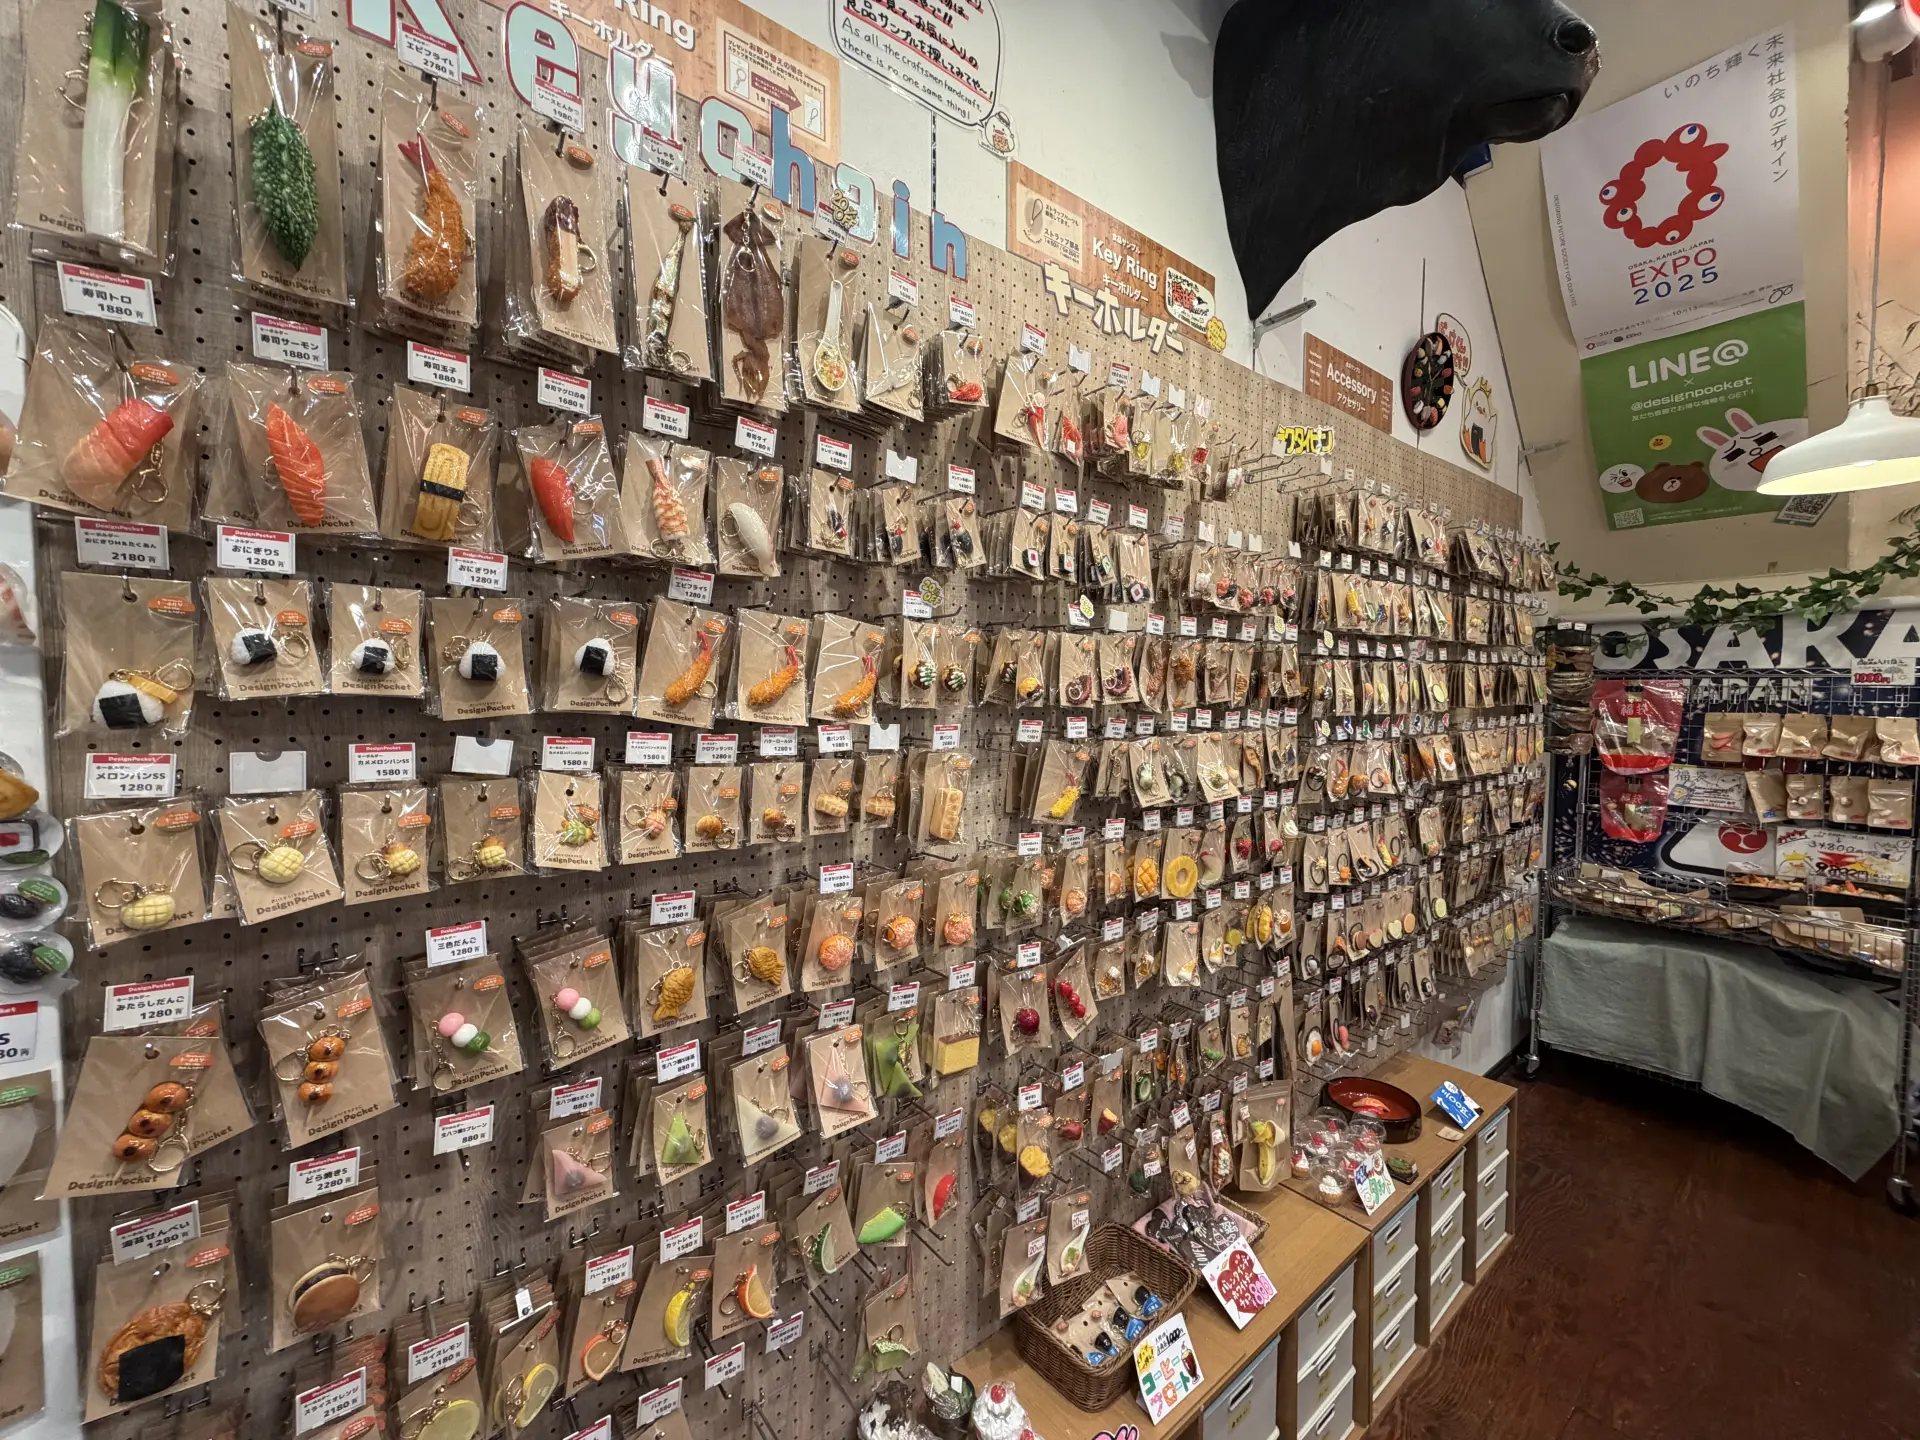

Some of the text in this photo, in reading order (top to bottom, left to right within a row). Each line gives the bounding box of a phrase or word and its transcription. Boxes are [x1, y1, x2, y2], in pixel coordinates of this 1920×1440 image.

[612, 0, 695, 50] Ring
[842, 17, 860, 38] As
[864, 28, 879, 48] all
[883, 43, 900, 60] the
[406, 41, 454, 67] エビフライL
[841, 37, 970, 120] there is no one same thing!
[1664, 42, 1760, 99] いのち輝く
[1765, 33, 1788, 184] 未来社会のデザイン
[1093, 236, 1123, 271] Key
[1126, 255, 1158, 290] Ring
[1628, 238, 1715, 271] OSAKA, KANSAI, JAPAN
[1629, 247, 1718, 289] EXPO
[1102, 272, 1149, 302] キーホルダー
[1633, 266, 1719, 306] 2025
[82, 287, 132, 305] 寿司トロ
[97, 303, 144, 319] 1880円
[1043, 260, 1184, 354] キーホルダー
[261, 334, 319, 351] 寿司サーモン
[283, 349, 319, 363] 1880円
[1628, 339, 1749, 389] LINE@
[423, 361, 457, 374] 寿司玉子
[433, 372, 463, 386] 1880円
[1327, 362, 1377, 405] Accessory
[558, 396, 584, 409] 1680円
[1337, 392, 1366, 412] アクセサリー
[1631, 377, 1753, 411] @designpocket
[654, 412, 678, 424] 寿司エビ
[660, 422, 683, 433] 1880円
[95, 523, 144, 532] DesignPocket
[235, 530, 276, 539] DesignPocket
[112, 552, 156, 563] 2180円
[231, 545, 280, 557] おにぎりS
[562, 544, 613, 555] DesignPocket
[246, 557, 285, 568] 1280円
[458, 564, 497, 576] おにぎりM
[470, 575, 500, 585] 1280円
[675, 581, 708, 593] エビフライS
[457, 703, 516, 715] DesignPocket
[652, 710, 695, 723] DesignPocket
[96, 772, 166, 780] メロンパンSS
[376, 768, 408, 776] 1580円
[355, 880, 421, 897] DesignPocket
[257, 889, 331, 916] DesignPocket
[451, 946, 480, 957] 1280円
[128, 981, 175, 993] DesignPocket
[140, 1008, 183, 1020] 1280円
[308, 1104, 380, 1136] DesignPocket
[462, 1132, 485, 1144] 880円
[68, 1173, 158, 1191] DesignPocket
[304, 1167, 348, 1184] どら焼きS
[317, 1177, 351, 1191] 2280円
[555, 1189, 606, 1214] DesignPocket
[147, 1232, 189, 1249] 1280円
[415, 1341, 462, 1366] スライスレモン
[431, 1352, 461, 1368] 2180円
[304, 1386, 359, 1416] スライスオレンジ
[323, 1396, 359, 1418] 2180円
